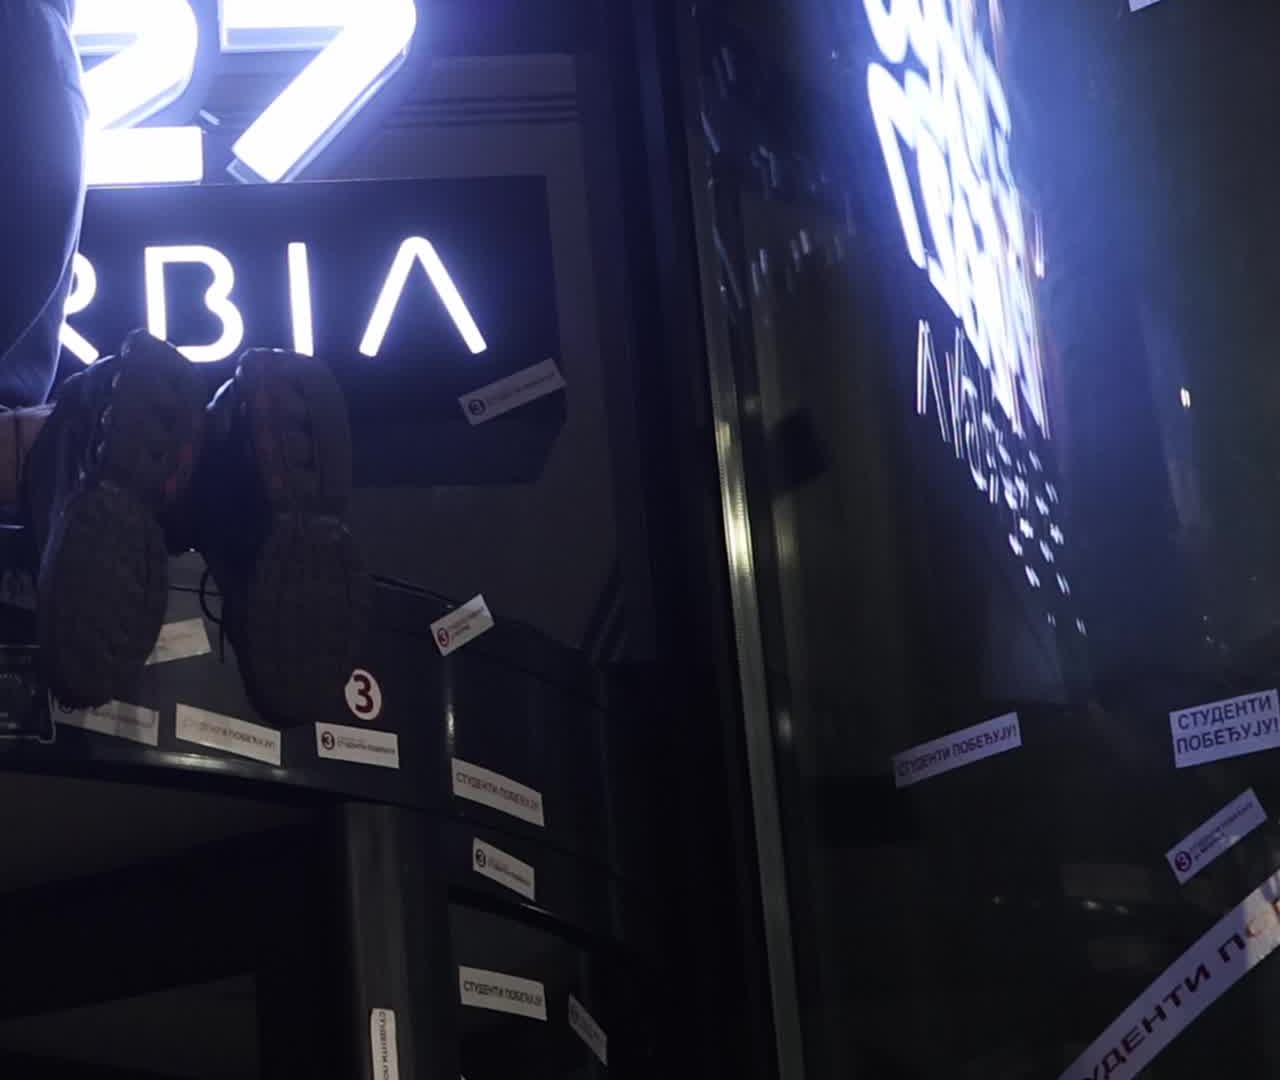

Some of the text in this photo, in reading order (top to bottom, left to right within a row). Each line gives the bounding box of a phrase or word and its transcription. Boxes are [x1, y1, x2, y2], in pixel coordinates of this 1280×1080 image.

[354, 674, 374, 713] 3
[1178, 695, 1273, 730] СТУДЕНТИ
[1176, 717, 1280, 753] ПОБЕЂУЈУ!
